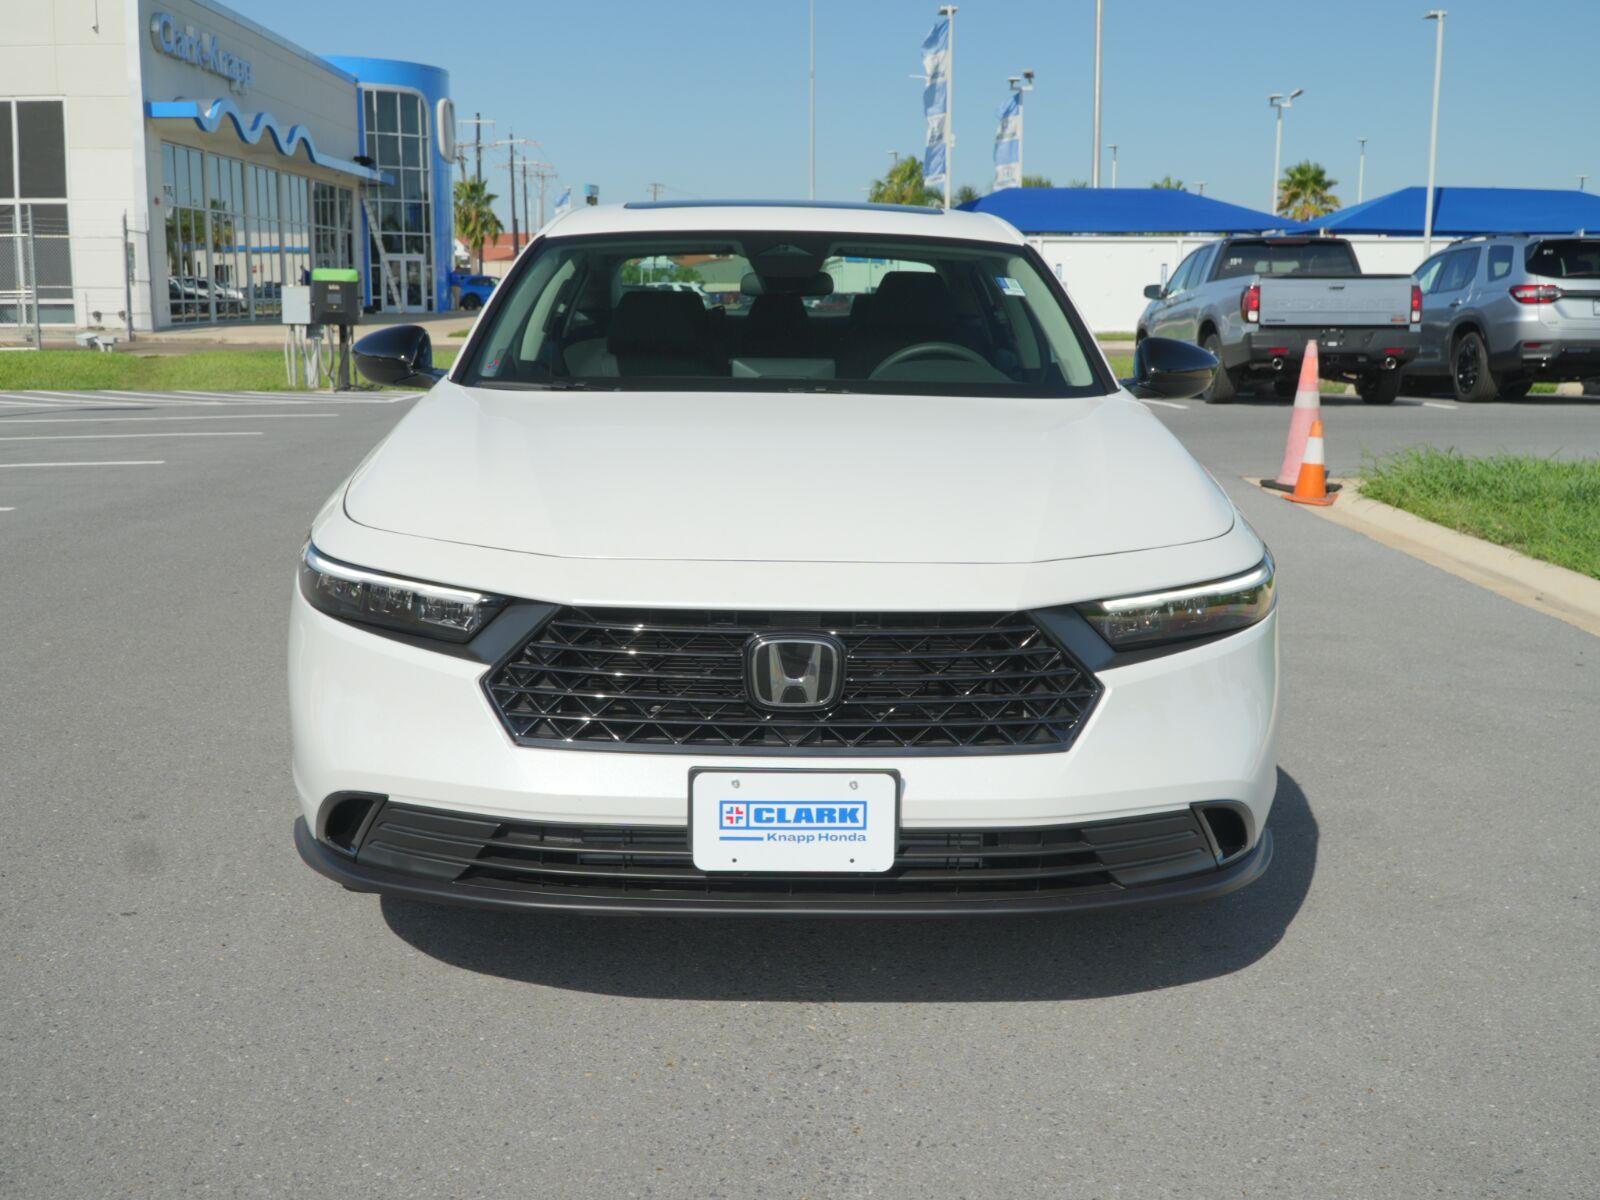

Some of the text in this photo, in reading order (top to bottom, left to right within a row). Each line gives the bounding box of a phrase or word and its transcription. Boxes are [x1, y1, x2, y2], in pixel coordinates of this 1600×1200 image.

[753, 807, 860, 824] CLARK
[766, 833, 866, 844] Knapp Honda
